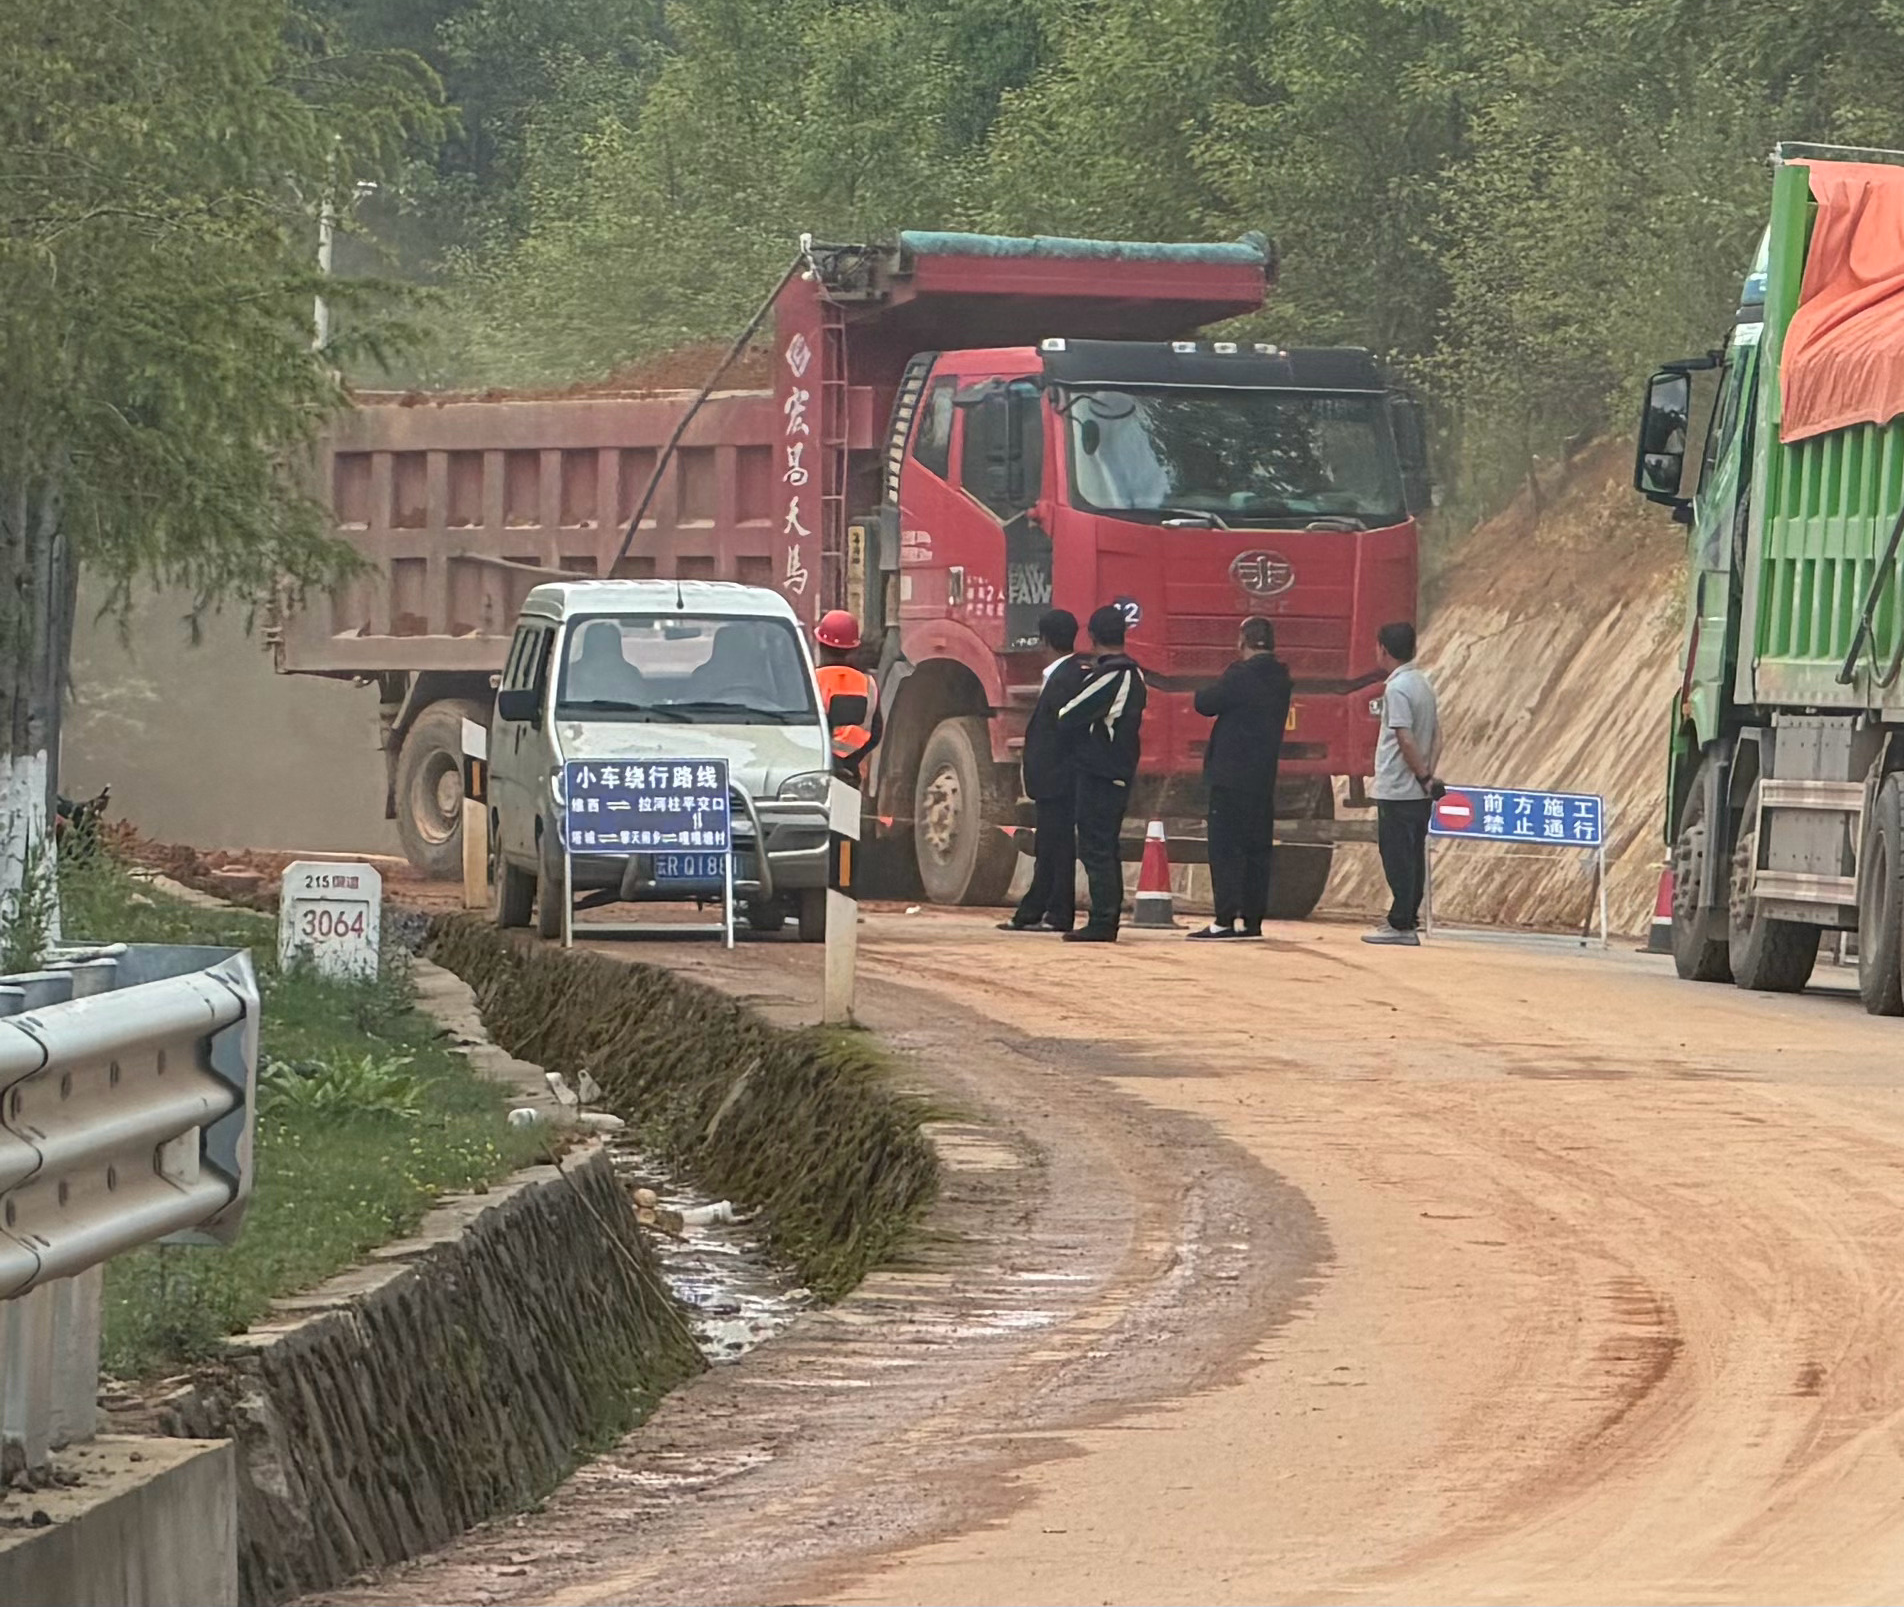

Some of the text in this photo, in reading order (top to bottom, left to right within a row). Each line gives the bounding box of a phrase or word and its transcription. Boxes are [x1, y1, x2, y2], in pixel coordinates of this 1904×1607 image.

[576, 765, 719, 790] 小车绕行路线
[1483, 793, 1595, 818] 前方施工
[1483, 814, 1596, 840] 禁止通行
[302, 909, 365, 939] 3064
